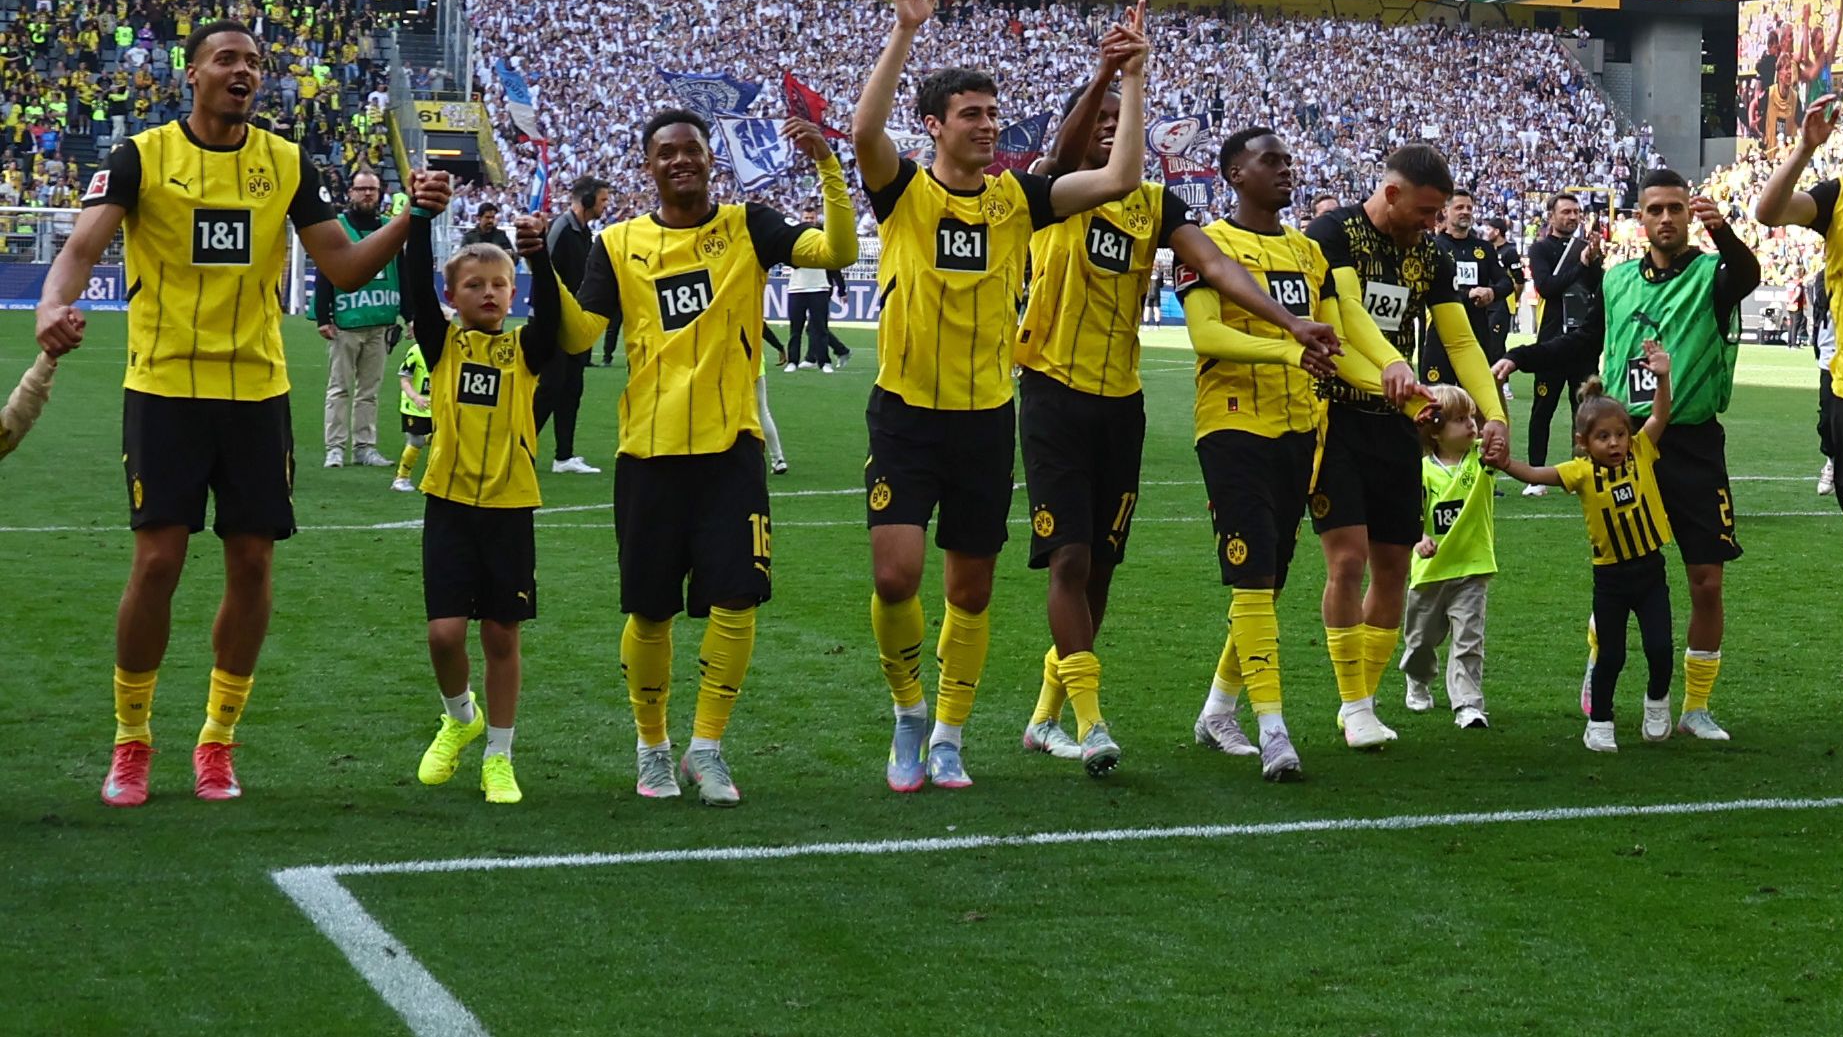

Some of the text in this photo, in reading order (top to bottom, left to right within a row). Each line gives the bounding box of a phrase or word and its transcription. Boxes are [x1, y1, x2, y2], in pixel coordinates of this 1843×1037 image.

[419, 110, 440, 123] 61
[250, 177, 270, 193] BVB
[1129, 212, 1148, 228] BVB
[198, 221, 244, 250] 1&1
[940, 229, 982, 257] 1&1
[1091, 227, 1128, 261] 1&1
[1459, 266, 1476, 279] 1&1
[79, 276, 115, 300] &1
[662, 282, 708, 316] 1&1
[1270, 279, 1305, 304] 1&1
[1368, 294, 1401, 319] 1&1
[463, 372, 502, 396] 1&1
[1631, 367, 1659, 392] 1&
[873, 486, 889, 504] BVB
[1613, 485, 1633, 503] 1&1
[1717, 488, 1732, 527] 2
